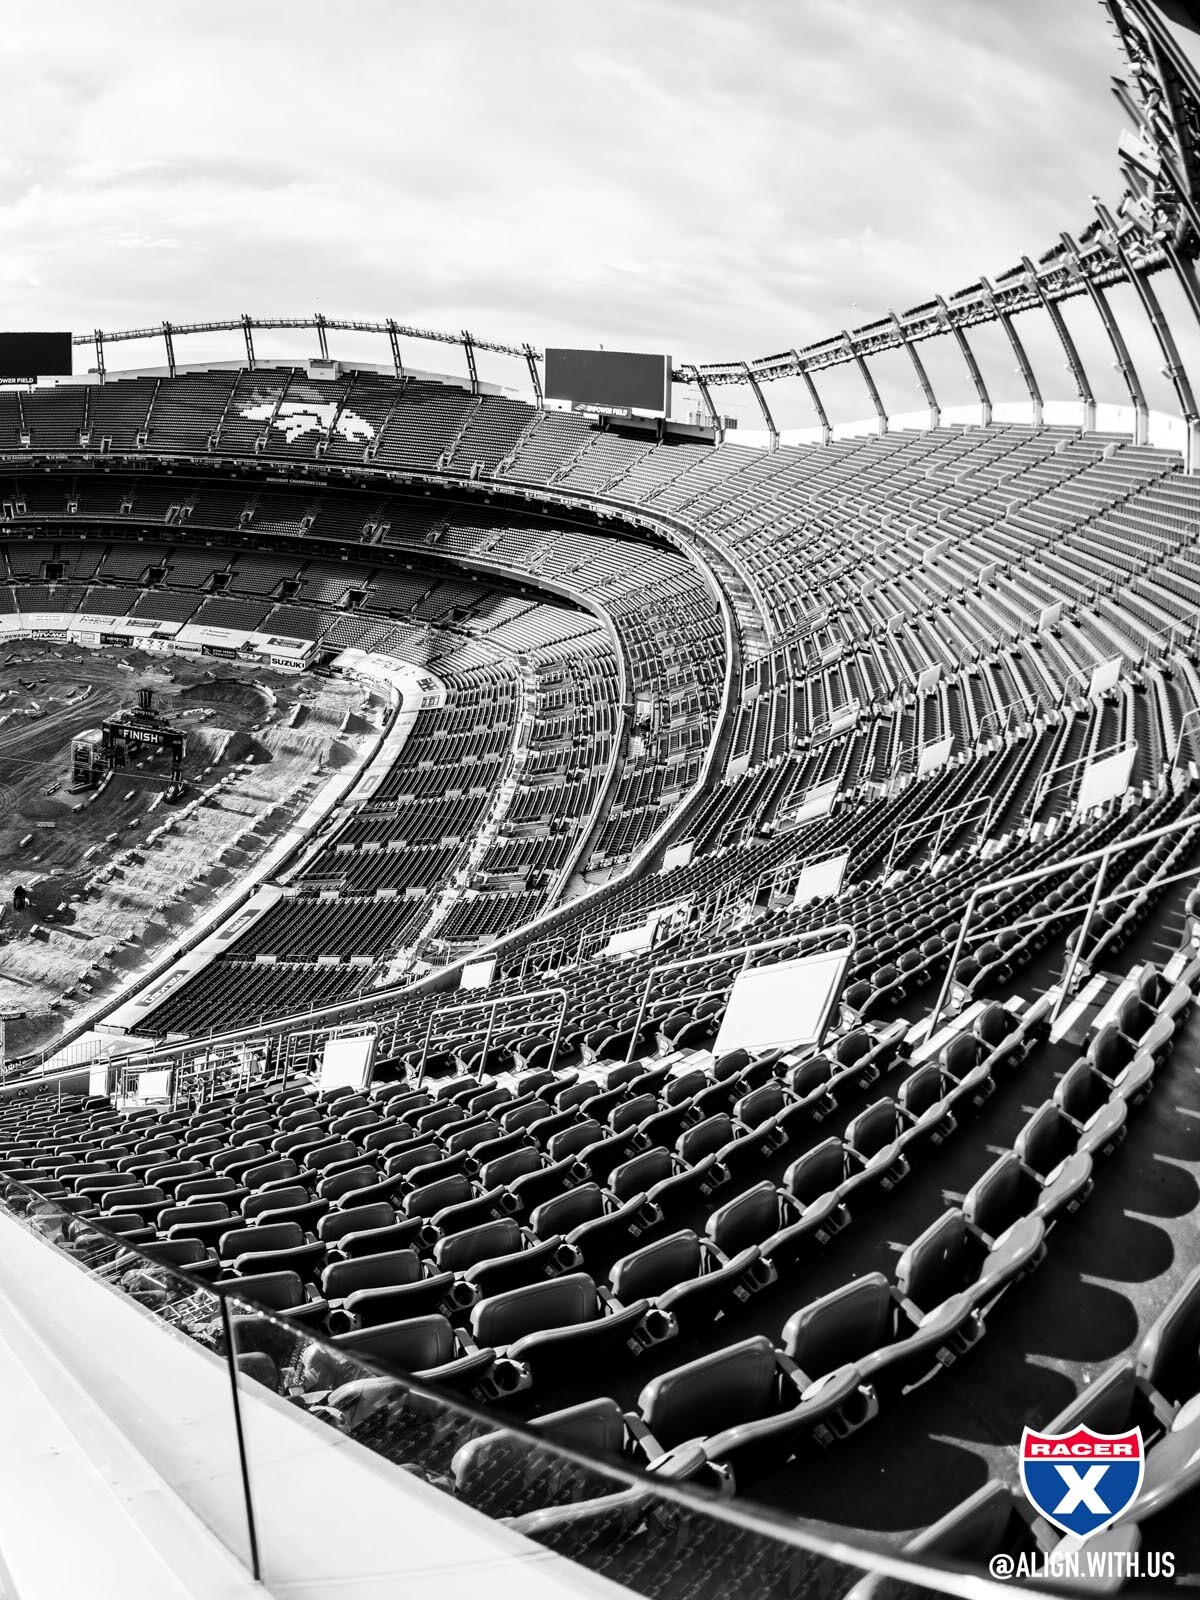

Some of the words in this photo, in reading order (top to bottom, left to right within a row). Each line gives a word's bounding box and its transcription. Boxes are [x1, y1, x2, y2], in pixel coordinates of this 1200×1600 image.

[586, 405, 613, 414] EMPOWER
[613, 408, 628, 416] FIELD
[271, 658, 305, 669] SUZUKI
[123, 729, 158, 743] FINISH
[142, 973, 184, 1004] FALKEN
